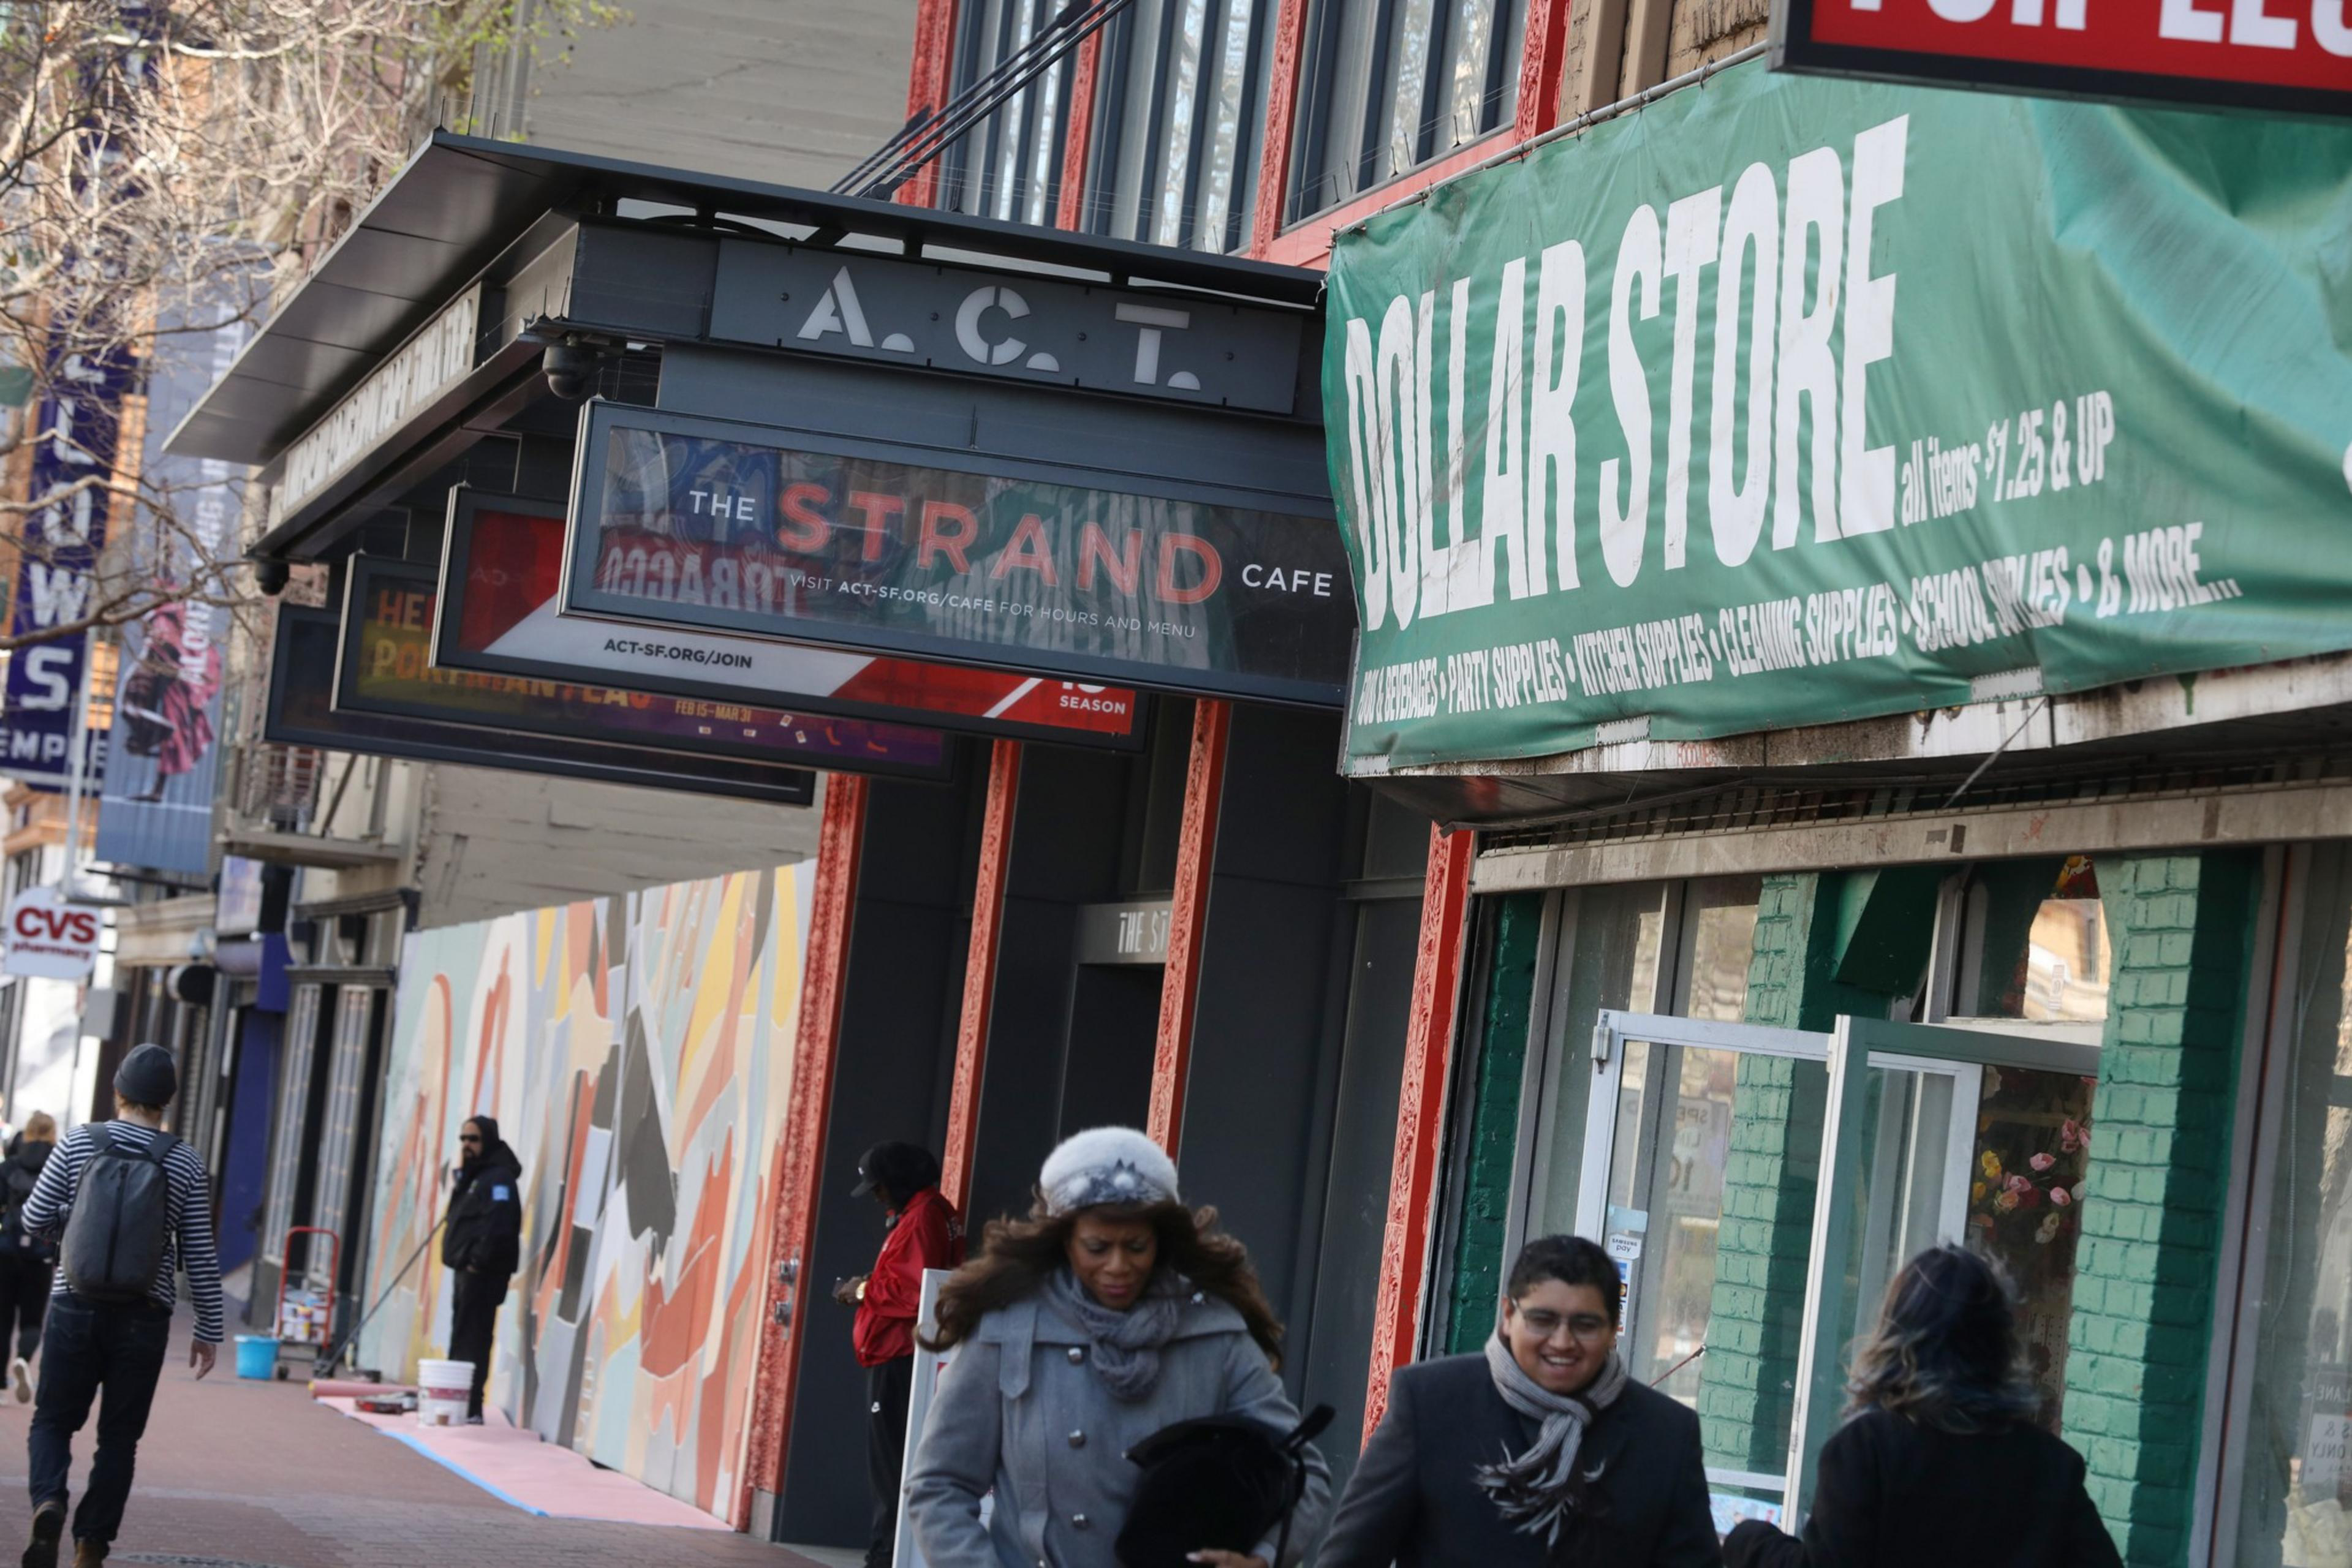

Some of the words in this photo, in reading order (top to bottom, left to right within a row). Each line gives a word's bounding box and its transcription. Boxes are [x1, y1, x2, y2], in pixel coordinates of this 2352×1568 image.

[1343, 238, 1586, 632] DOLLAR
[1598, 113, 1910, 588] STORE
[1901, 439, 1928, 527] all
[1928, 435, 1981, 519] items
[1984, 408, 2045, 502] $1.25
[2049, 400, 2071, 491] &
[2076, 390, 2116, 486] UP
[689, 490, 755, 521] THE
[778, 483, 1222, 605] STRAND
[1241, 563, 1333, 597] CAFE
[377, 589, 437, 632] HE
[790, 574, 833, 591] VISIT
[838, 581, 993, 612] ACT-SF.ORG/CAFE
[1000, 601, 1034, 617] FOR
[1040, 606, 1098, 625] HOURS
[1104, 615, 1141, 631] AND
[1148, 621, 1196, 638] MENU
[1384, 657, 1438, 722] BEVERAGES
[1447, 649, 1491, 714] PARTY
[1492, 638, 1568, 709] SUPPLIES
[1573, 625, 1643, 696] KITCHEN
[1635, 612, 1713, 690] SUPPLIES
[1719, 596, 1806, 677] CLEANING
[1804, 581, 1898, 666] SUPPLIES
[1910, 565, 1997, 652] SCHOOL
[2096, 537, 2122, 619] &
[603, 638, 753, 669] ACT-SF.ORG/JOIN
[675, 699, 695, 716] FEB
[1059, 695, 1126, 715] SEASON
[15, 906, 96, 944] CVS
[1118, 911, 1145, 954] THE
[1616, 1244, 1632, 1253] pay
